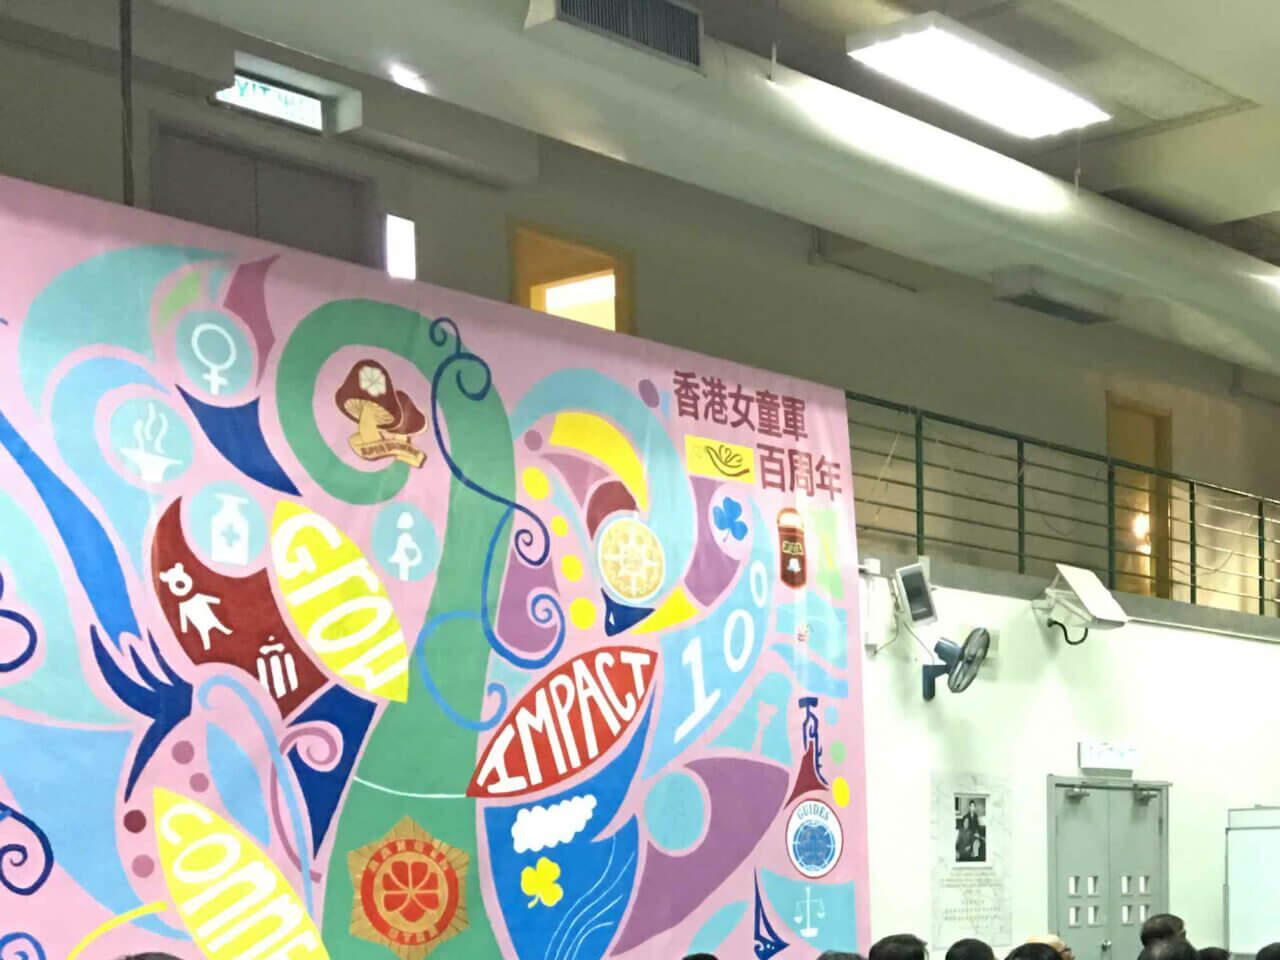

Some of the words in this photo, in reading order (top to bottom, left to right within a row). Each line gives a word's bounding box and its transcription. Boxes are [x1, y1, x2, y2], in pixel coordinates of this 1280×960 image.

[673, 370, 808, 441] 香港女童軍
[756, 443, 842, 500] 百周年
[476, 650, 651, 793] IMPACT
[797, 801, 830, 821] GUIDES
